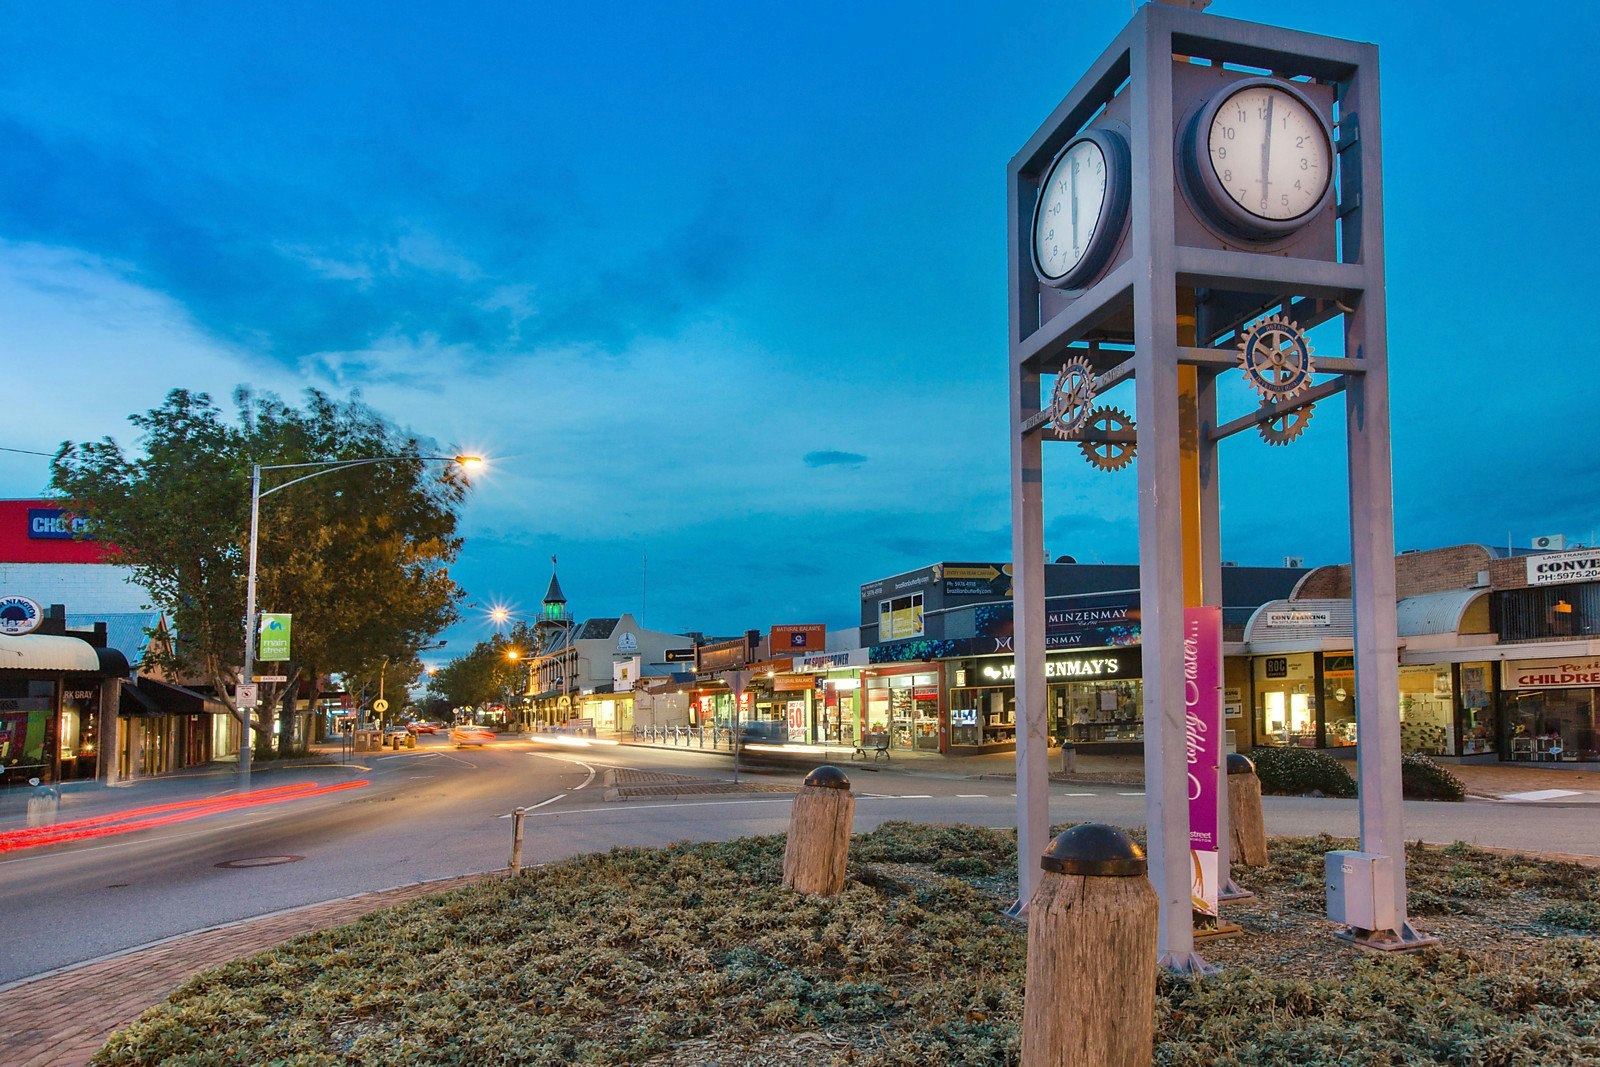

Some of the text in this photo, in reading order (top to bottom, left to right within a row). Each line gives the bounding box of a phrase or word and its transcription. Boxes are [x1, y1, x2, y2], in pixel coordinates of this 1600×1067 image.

[1237, 110, 1246, 122] 11
[1283, 117, 1287, 129] 1
[1222, 126, 1235, 140] 10
[1295, 136, 1304, 149] 2
[1218, 147, 1227, 159] 9
[1300, 158, 1308, 171] 3
[1224, 169, 1233, 182] 8
[1294, 179, 1302, 191] 4
[1239, 188, 1247, 201] 7
[1281, 194, 1289, 206] 5
[1260, 197, 1268, 210] 6
[1049, 229, 1055, 241] 9
[1053, 245, 1058, 257] 8
[1074, 246, 1080, 258] 6
[1265, 324, 1289, 332] ROTARY
[1537, 558, 1600, 573] CONVE
[1048, 609, 1128, 623] MINZENMAY
[1046, 635, 1081, 645] ENMAY
[1001, 658, 1119, 679] MENMAY'S
[1268, 660, 1286, 672] ROC
[1518, 672, 1600, 685] CHILDRE
[75, 690, 94, 699] GRAY
[788, 707, 804, 729] 50
